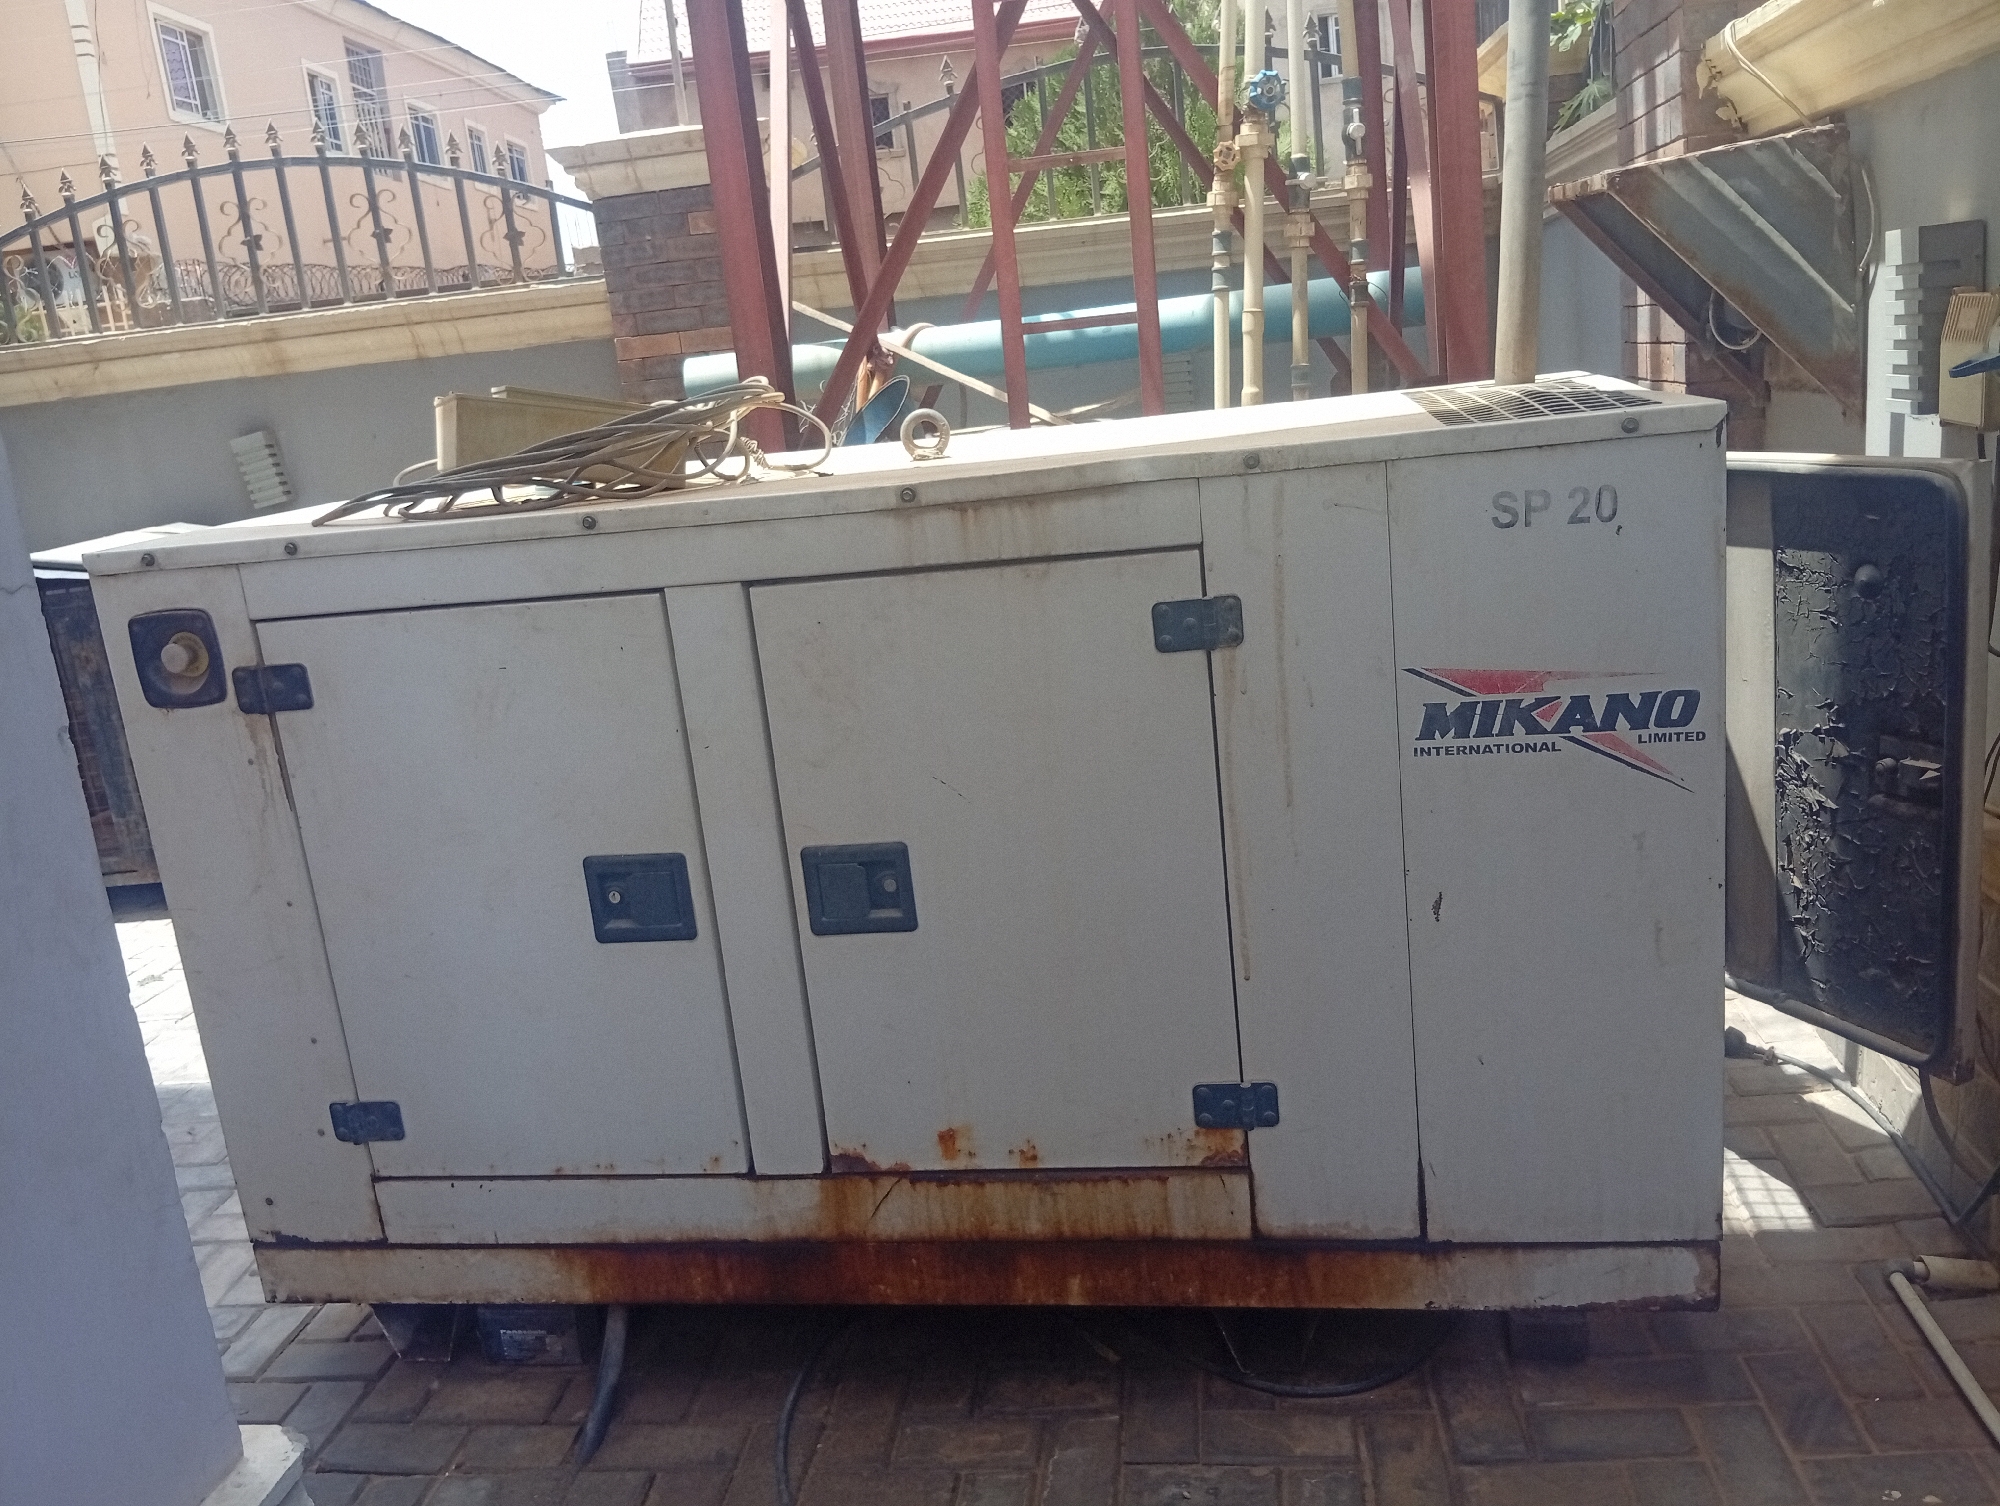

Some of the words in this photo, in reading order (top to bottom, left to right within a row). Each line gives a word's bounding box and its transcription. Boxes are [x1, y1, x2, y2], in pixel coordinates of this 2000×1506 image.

[1491, 489, 1550, 529] SP
[1567, 484, 1618, 525] 20
[1415, 689, 1700, 741] MIKANO
[1413, 741, 1561, 757] INTERNATIONAL
[1638, 731, 1706, 744] LIMITED
